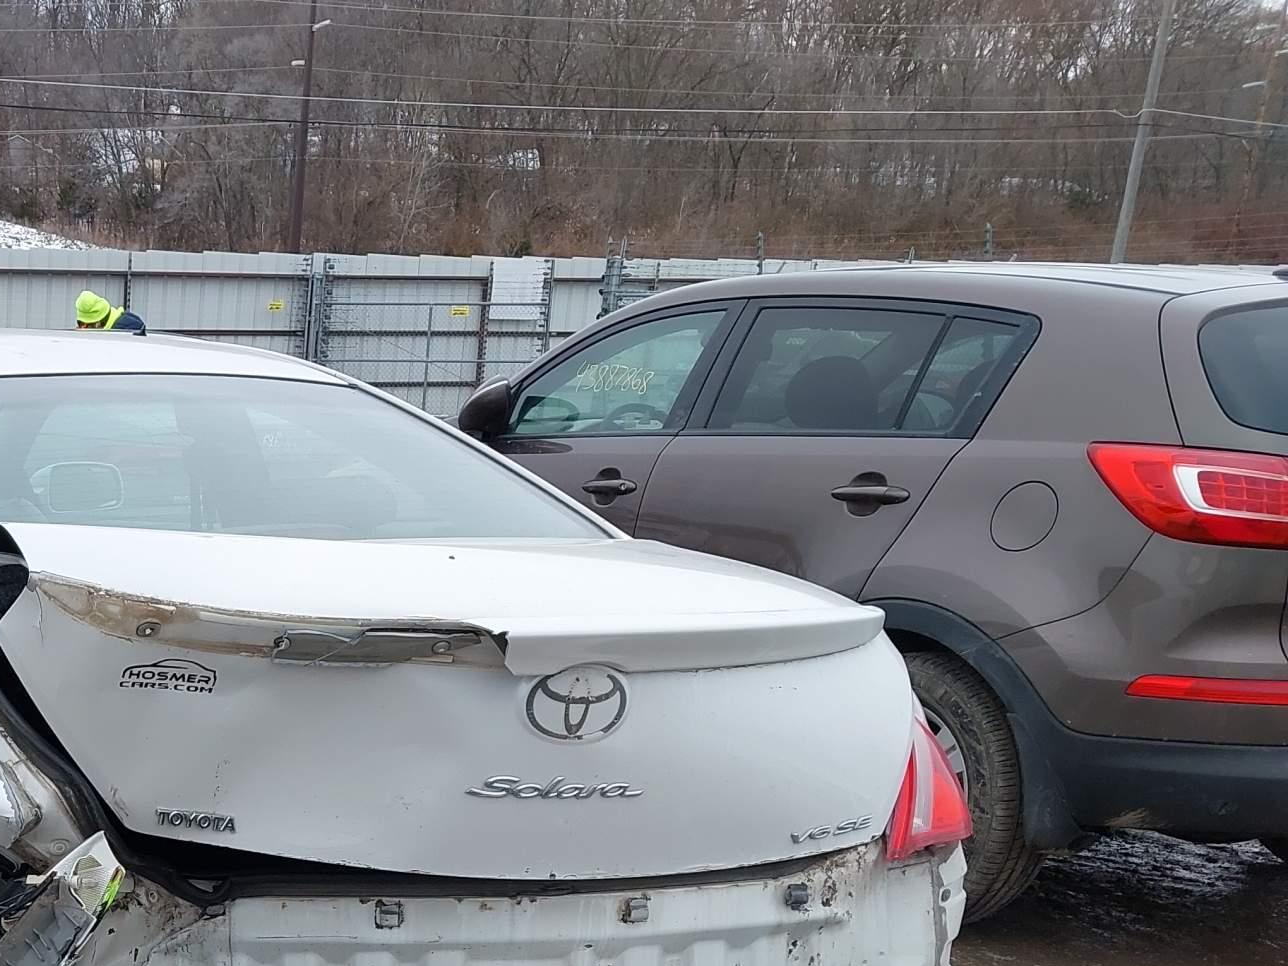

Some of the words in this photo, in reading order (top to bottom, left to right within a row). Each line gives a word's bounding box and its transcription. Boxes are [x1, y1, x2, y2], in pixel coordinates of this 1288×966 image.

[575, 360, 655, 395] 43887868
[119, 681, 214, 694] CARS.COM
[128, 670, 212, 685] HOSMER
[464, 775, 644, 800] Solara
[155, 808, 236, 834] TOYOTA
[791, 825, 832, 844] V6
[833, 814, 873, 836] SE
